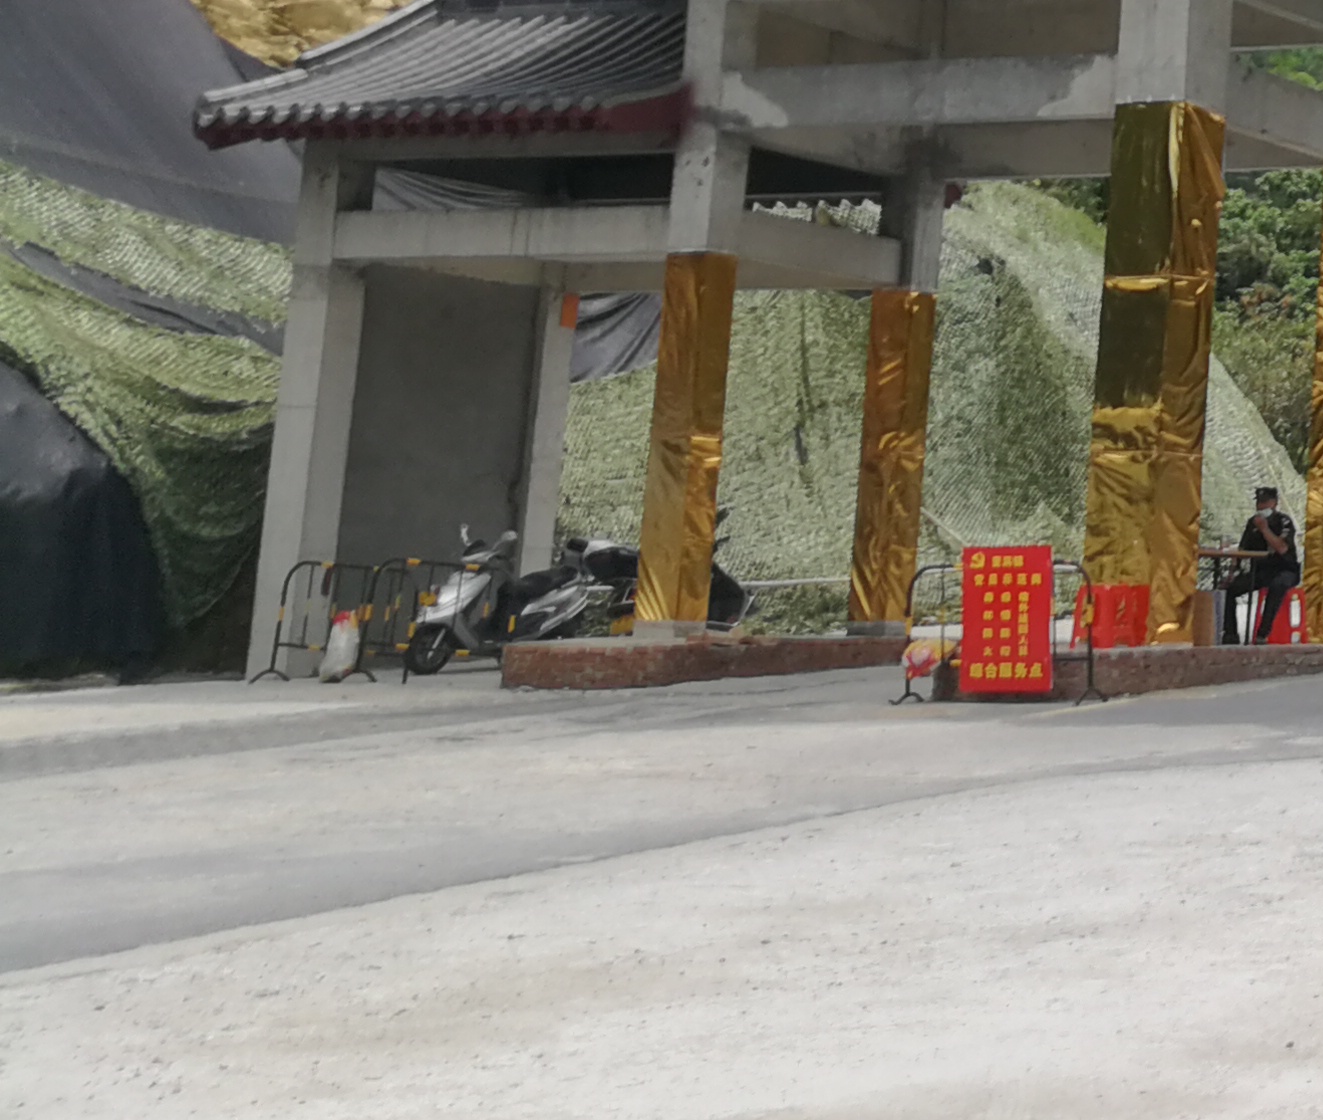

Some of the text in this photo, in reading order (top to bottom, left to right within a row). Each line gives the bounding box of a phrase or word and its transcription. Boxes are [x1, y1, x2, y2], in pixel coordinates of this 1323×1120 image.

[969, 662, 1043, 679] 综合服务点
